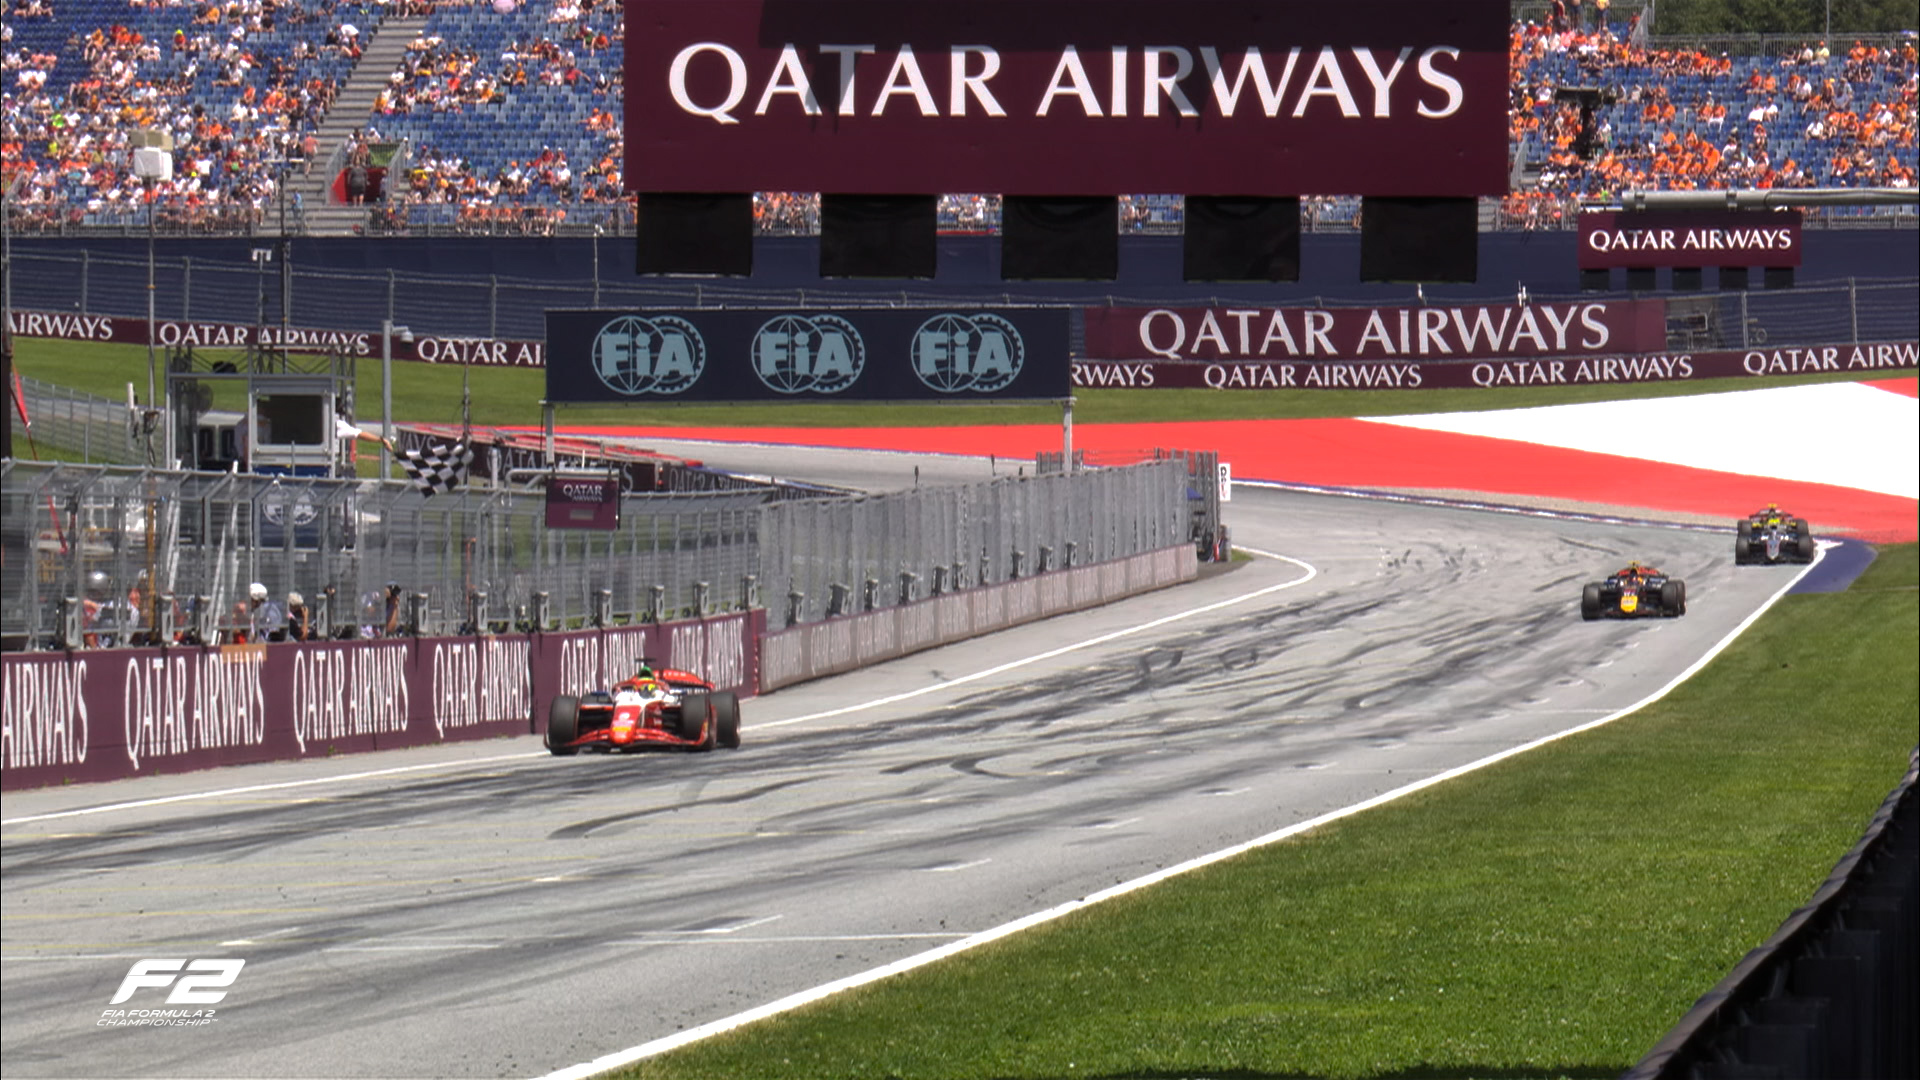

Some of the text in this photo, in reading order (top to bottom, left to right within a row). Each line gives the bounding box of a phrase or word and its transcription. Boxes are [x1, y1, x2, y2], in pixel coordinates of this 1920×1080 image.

[669, 42, 1464, 125] QATAR AIRWAYS
[1589, 228, 1792, 252] QATAR AIRWAYS
[159, 322, 249, 346] QATAR
[1139, 303, 1609, 360] QATAR AIRWAYS
[1204, 363, 1422, 390] QATAR AIRWAYS
[1471, 354, 1693, 387] QATAR AIRWAYS
[1743, 347, 1840, 376] QATAR
[562, 483, 603, 498] QATAR
[125, 650, 265, 771] QATAR AIRWAYS
[293, 643, 409, 754] QATAR AIRWAYS
[432, 639, 532, 739] QATAR AIRWAYS
[1, 658, 89, 770] AIRWAYS
